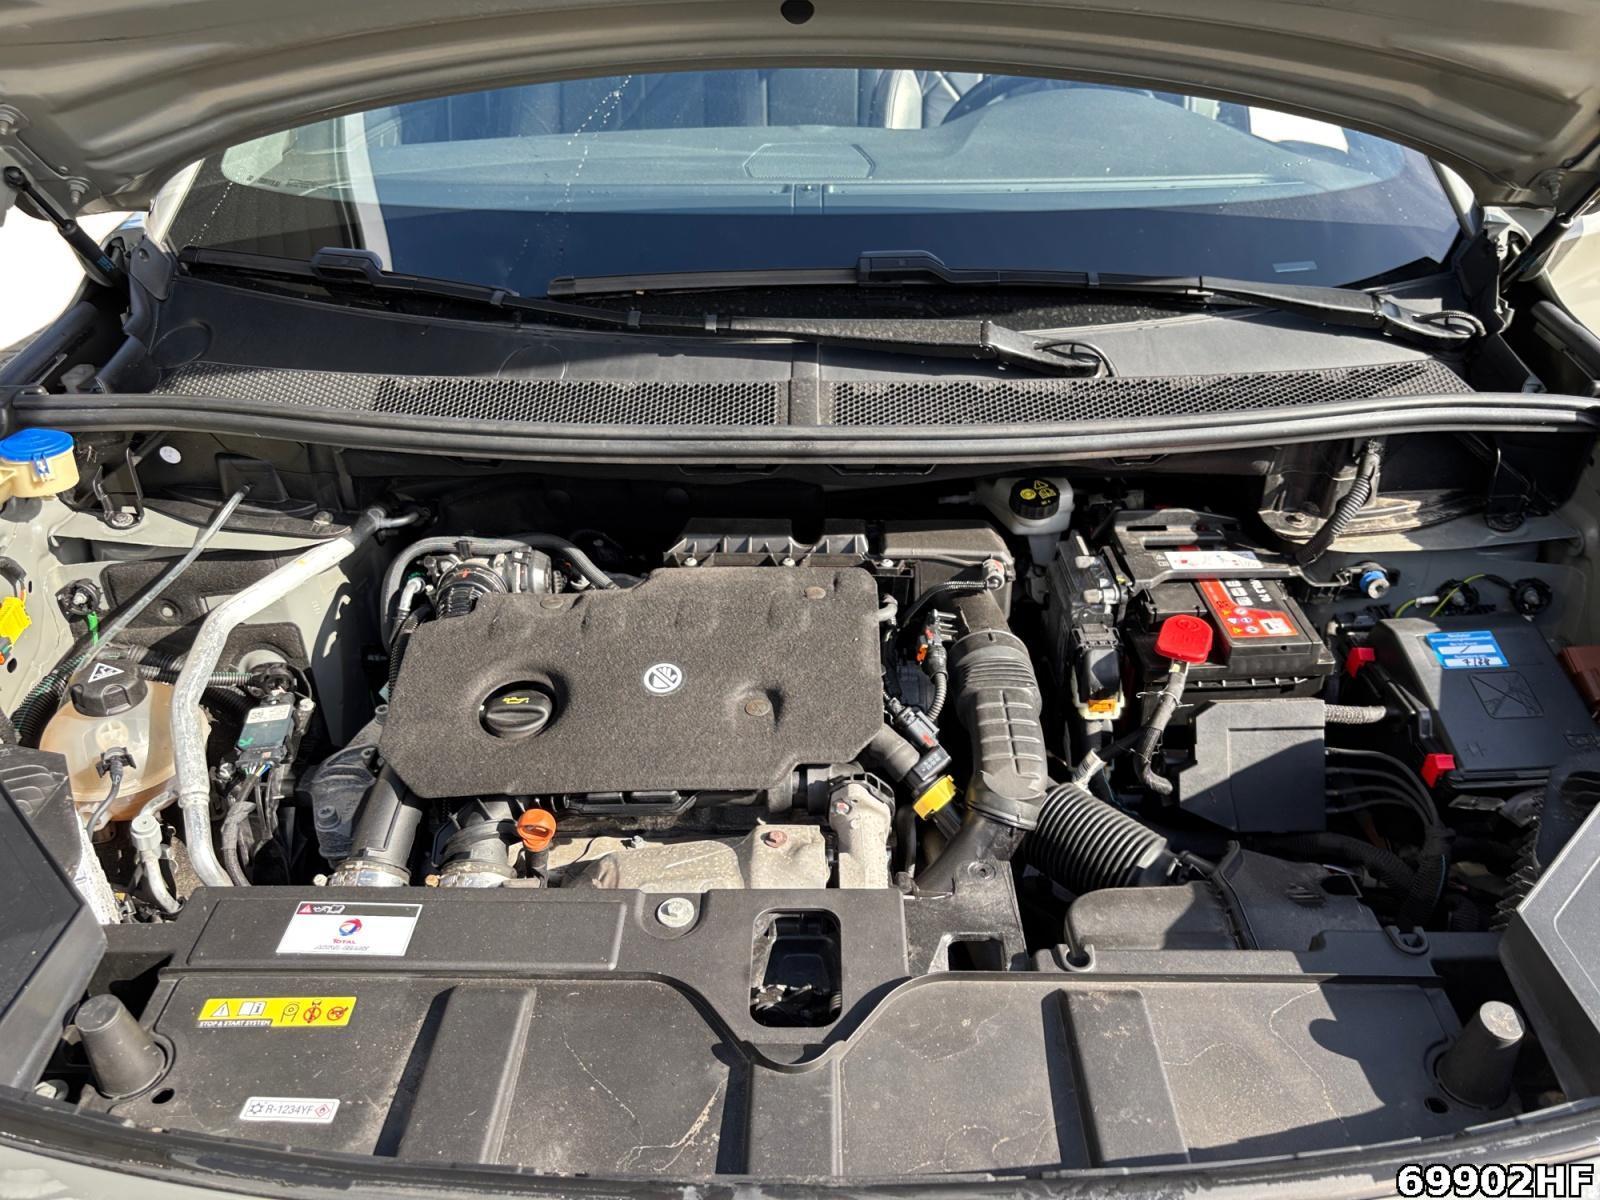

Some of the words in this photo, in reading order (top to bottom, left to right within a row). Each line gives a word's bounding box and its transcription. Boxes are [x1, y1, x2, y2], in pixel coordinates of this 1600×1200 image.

[200, 1020, 217, 1028] STOP
[224, 1020, 245, 1028] START
[265, 1104, 313, 1115] R-1234YF
